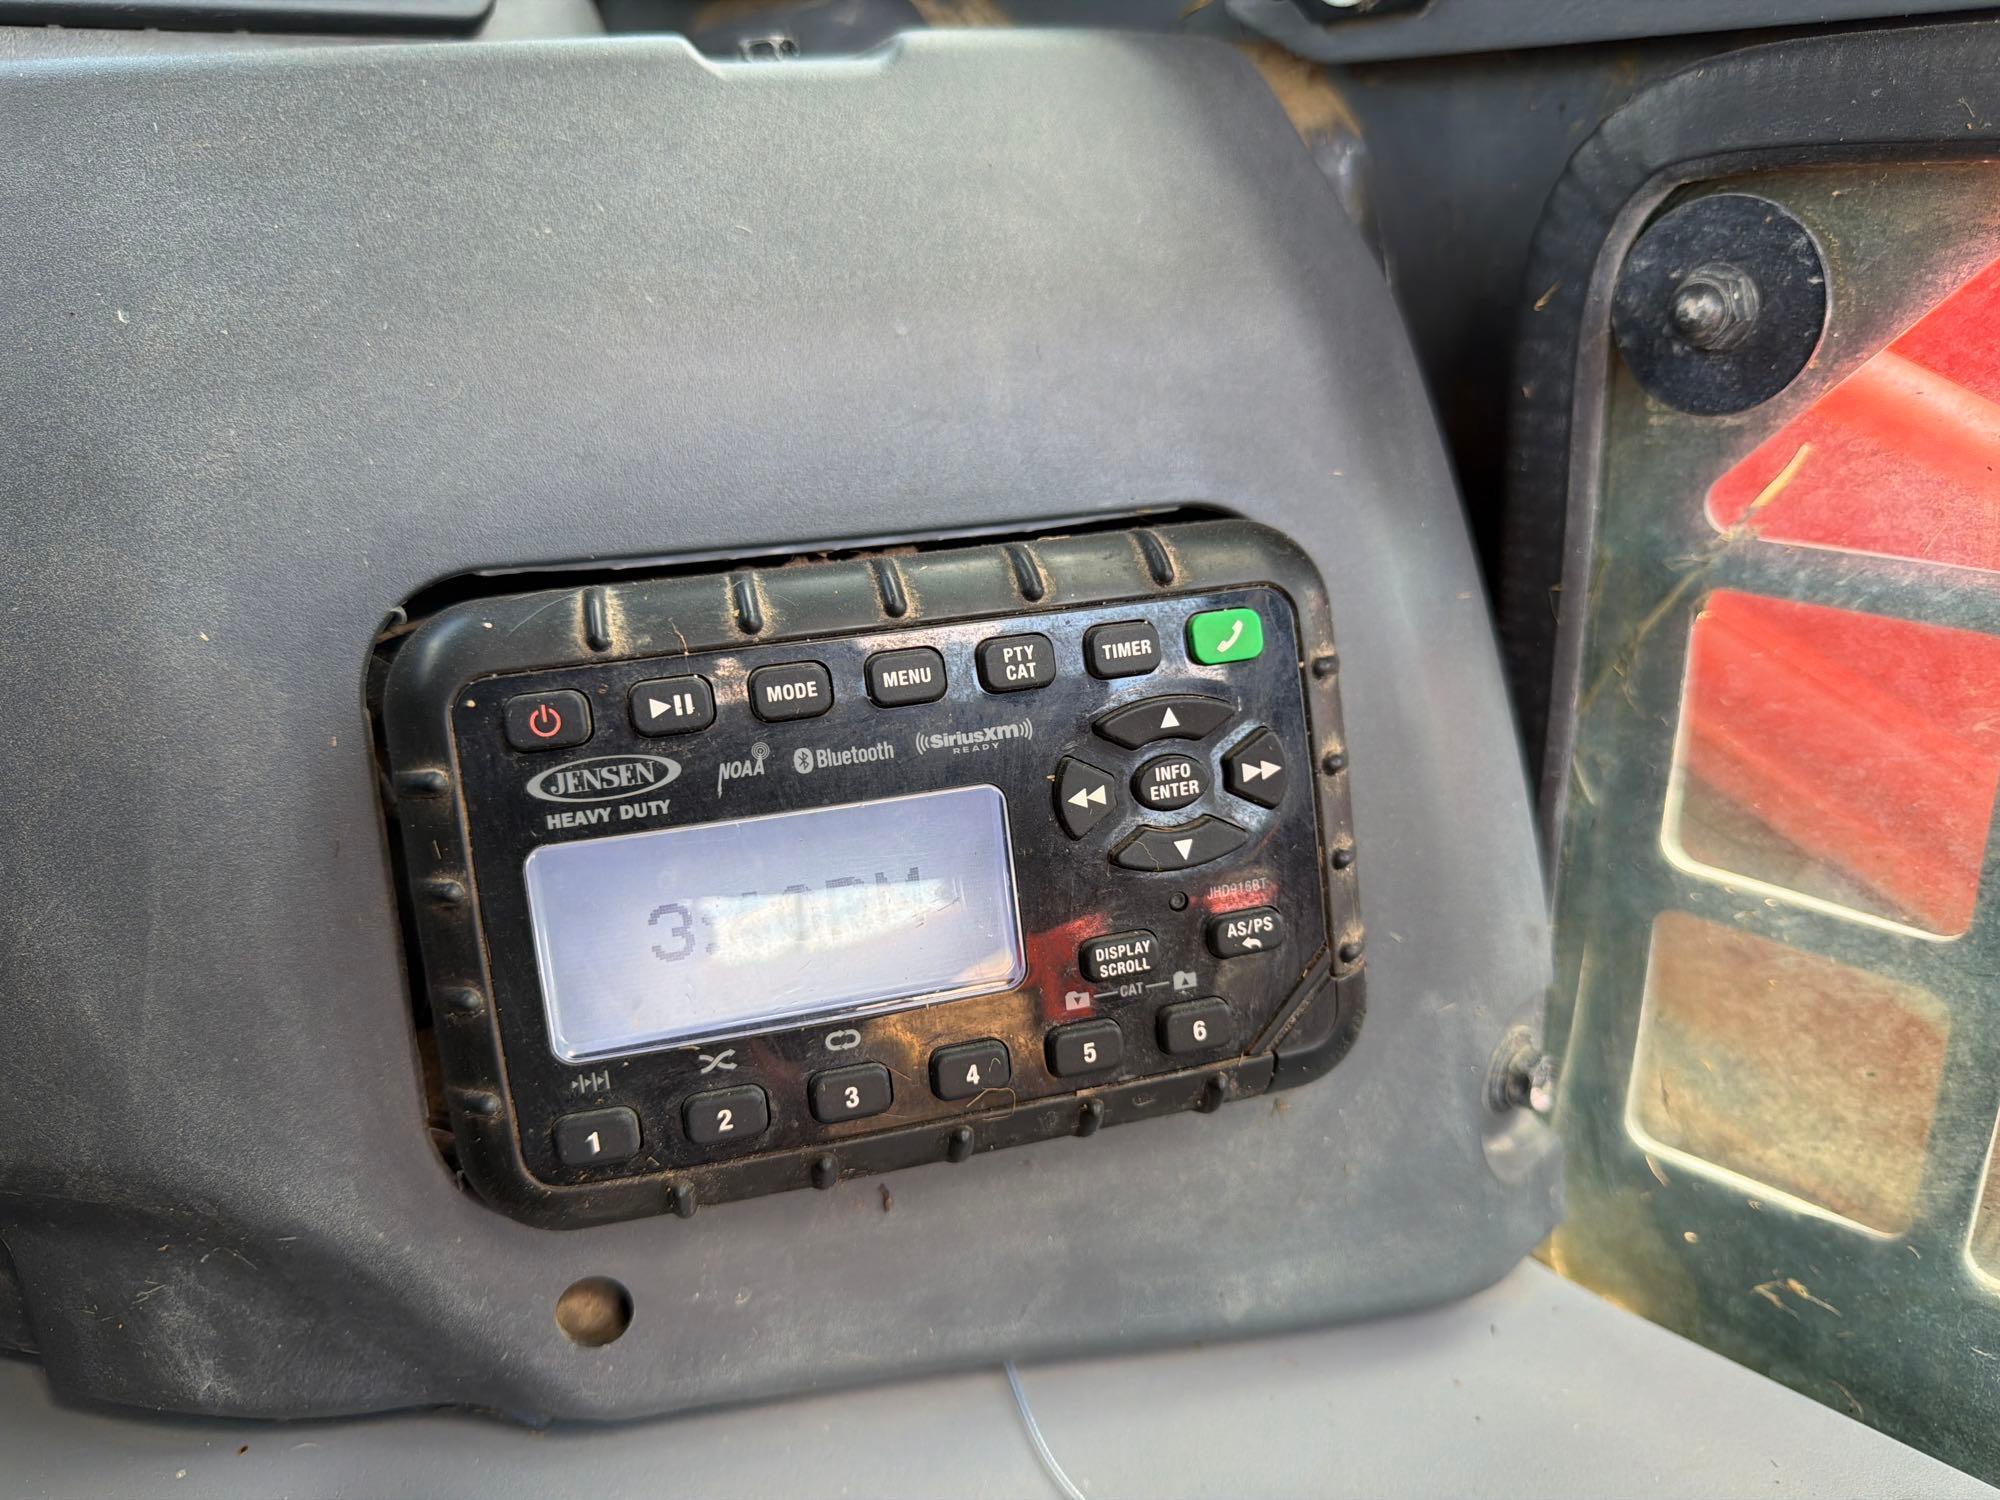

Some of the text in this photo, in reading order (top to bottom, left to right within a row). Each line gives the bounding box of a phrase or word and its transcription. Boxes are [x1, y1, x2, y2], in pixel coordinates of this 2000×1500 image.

[1003, 644, 1035, 664] PTY
[1102, 639, 1153, 660] TIMER
[882, 667, 932, 688] MENU
[1006, 662, 1037, 681] CAT
[766, 682, 818, 702] MODE
[816, 741, 895, 768] Bluetooth
[952, 741, 999, 755] READY
[551, 762, 656, 795] JENSEN
[1155, 764, 1192, 780] INFO
[1150, 779, 1201, 801] ENTER
[546, 799, 672, 830] HEAVY DUTY
[1227, 916, 1273, 938] AS/PS
[1096, 940, 1150, 962] DISPLAY
[1099, 958, 1151, 978] SCROLL
[1119, 982, 1144, 998] CAT
[1192, 1020, 1208, 1041] 6
[1083, 1042, 1098, 1064] 5
[965, 1063, 981, 1086] 4
[844, 1085, 861, 1110] 3
[716, 1108, 735, 1133] 2
[584, 1130, 603, 1155] 1
